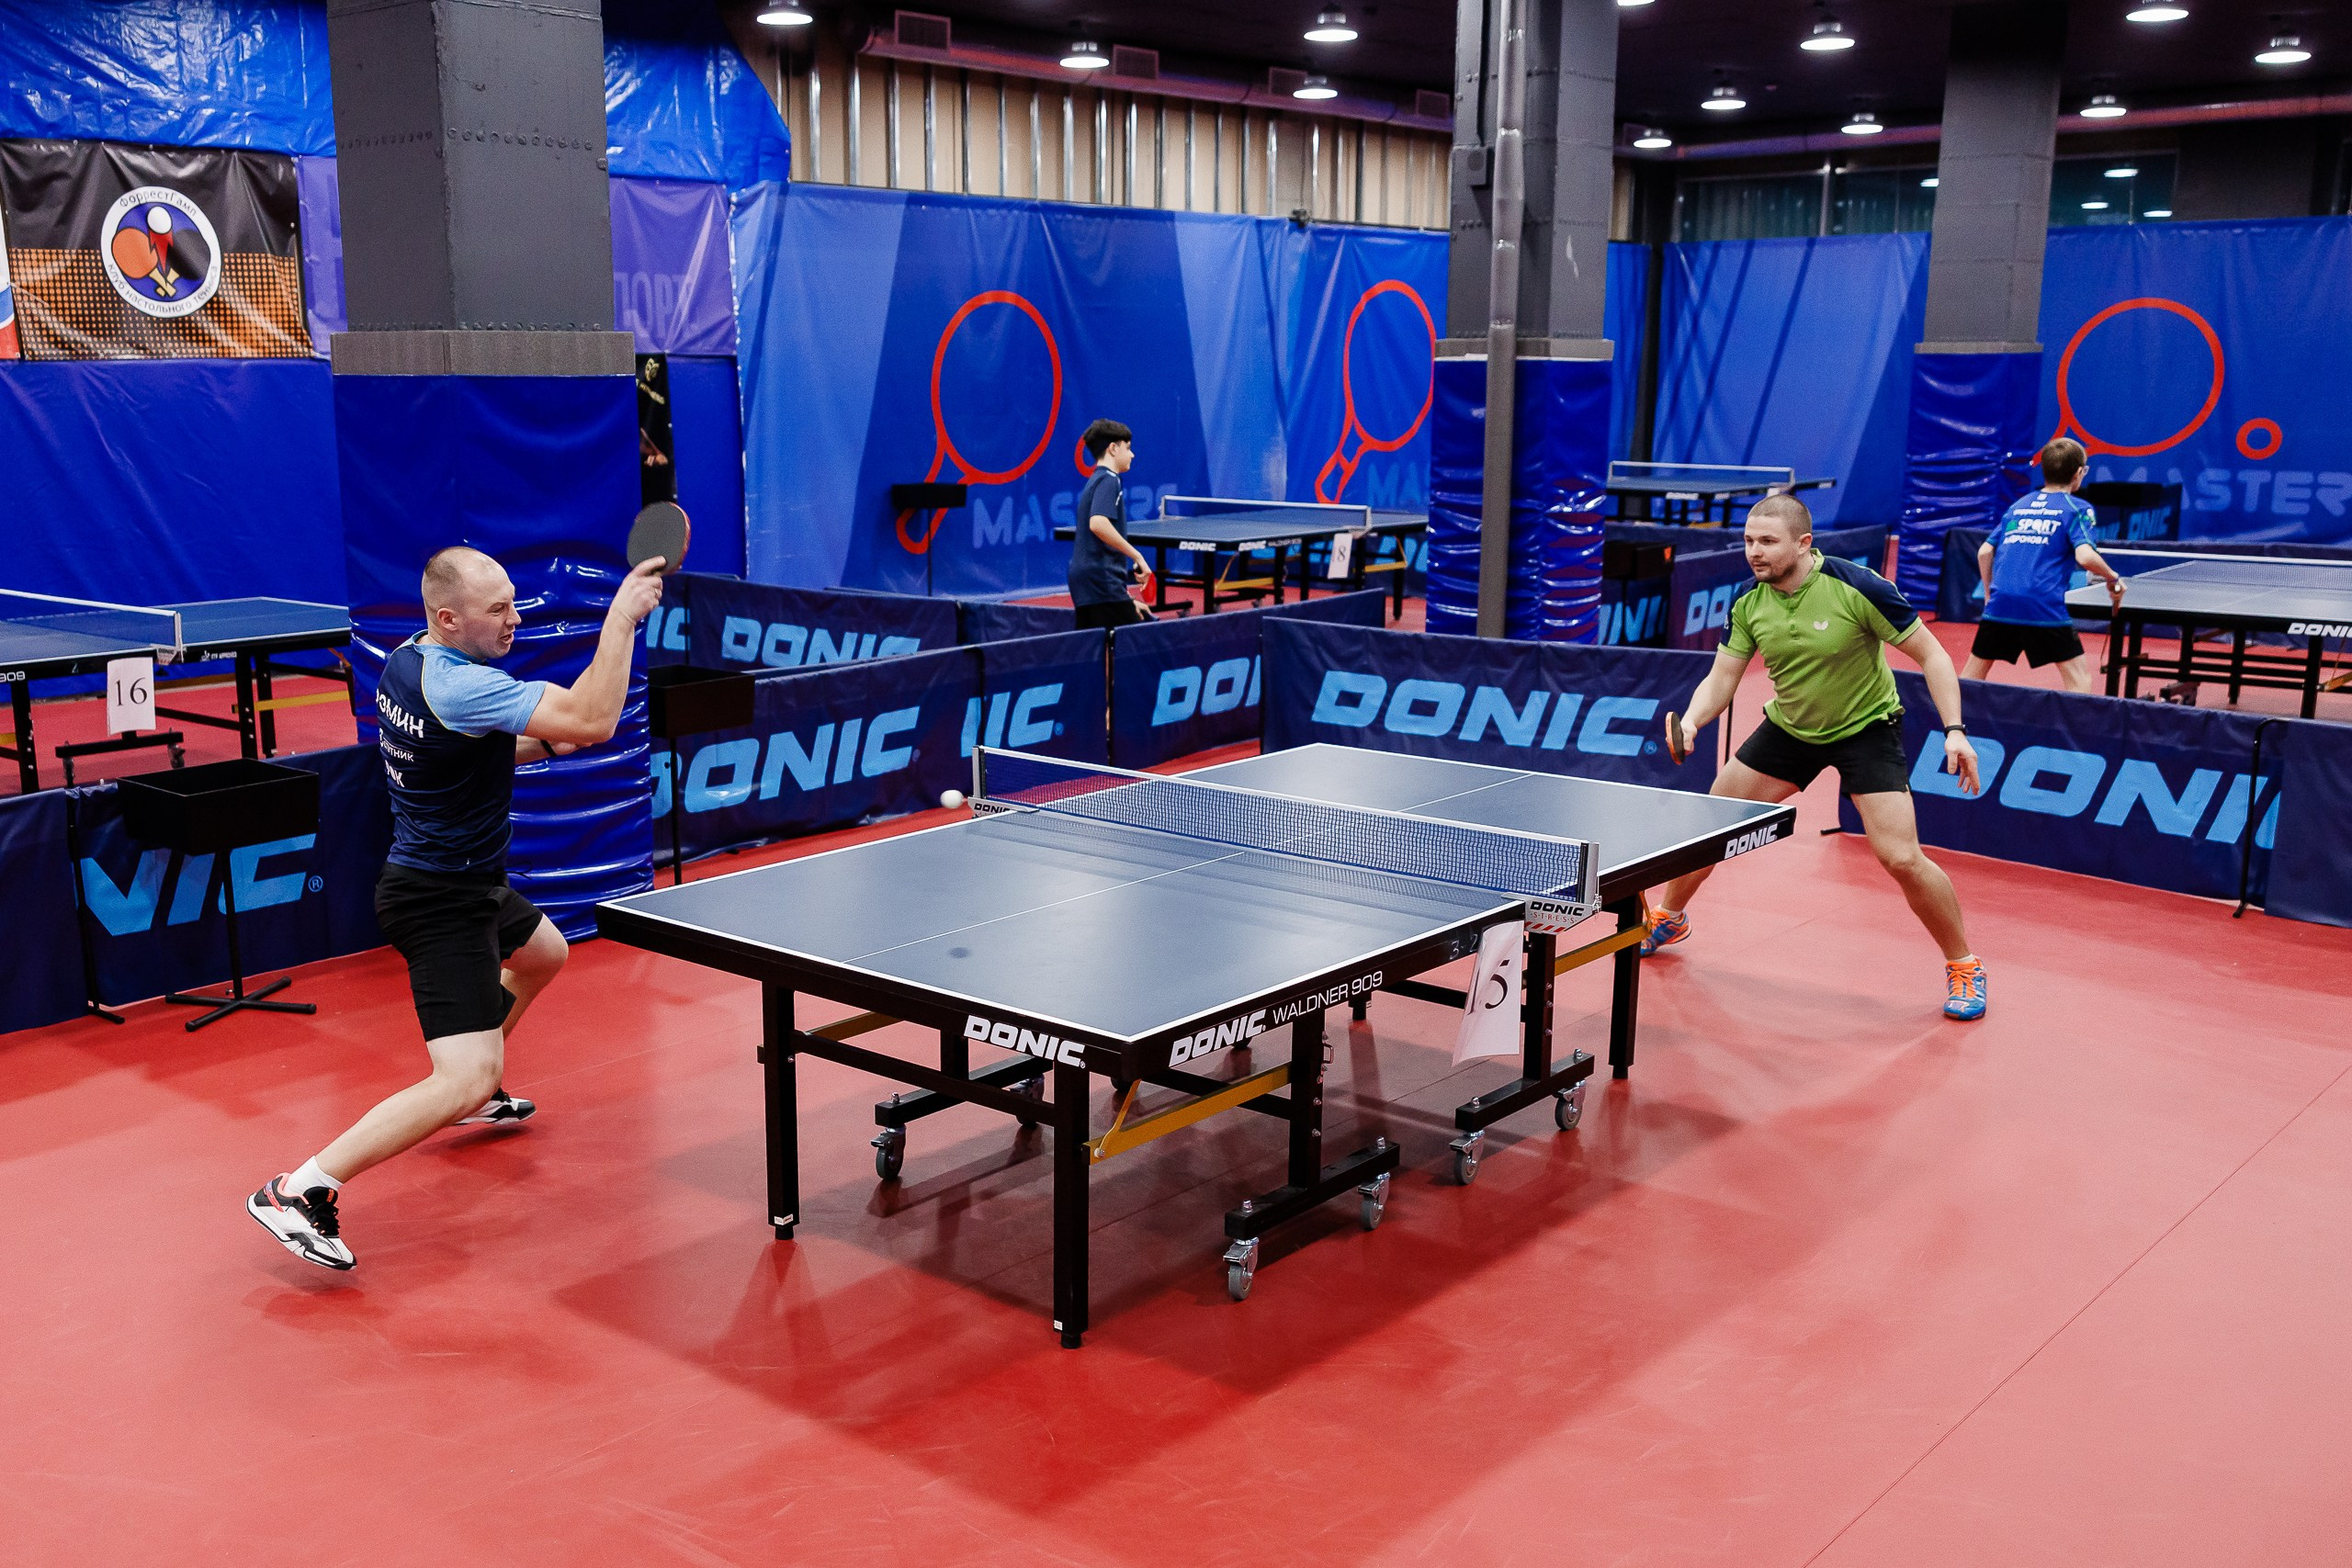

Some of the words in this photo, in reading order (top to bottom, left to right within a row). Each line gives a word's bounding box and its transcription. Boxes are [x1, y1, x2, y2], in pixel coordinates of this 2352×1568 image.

[1337, 546, 1347, 564] 8
[115, 677, 148, 706] 16
[1312, 671, 1658, 756] DONIC
[1724, 823, 1778, 860] DONIC
[1530, 901, 1585, 917] DONIC
[1169, 1009, 1266, 1067] DONIC
[1272, 983, 1349, 1024] WALDNER
[1351, 970, 1383, 996] 909
[964, 1014, 1085, 1067] DONIC
